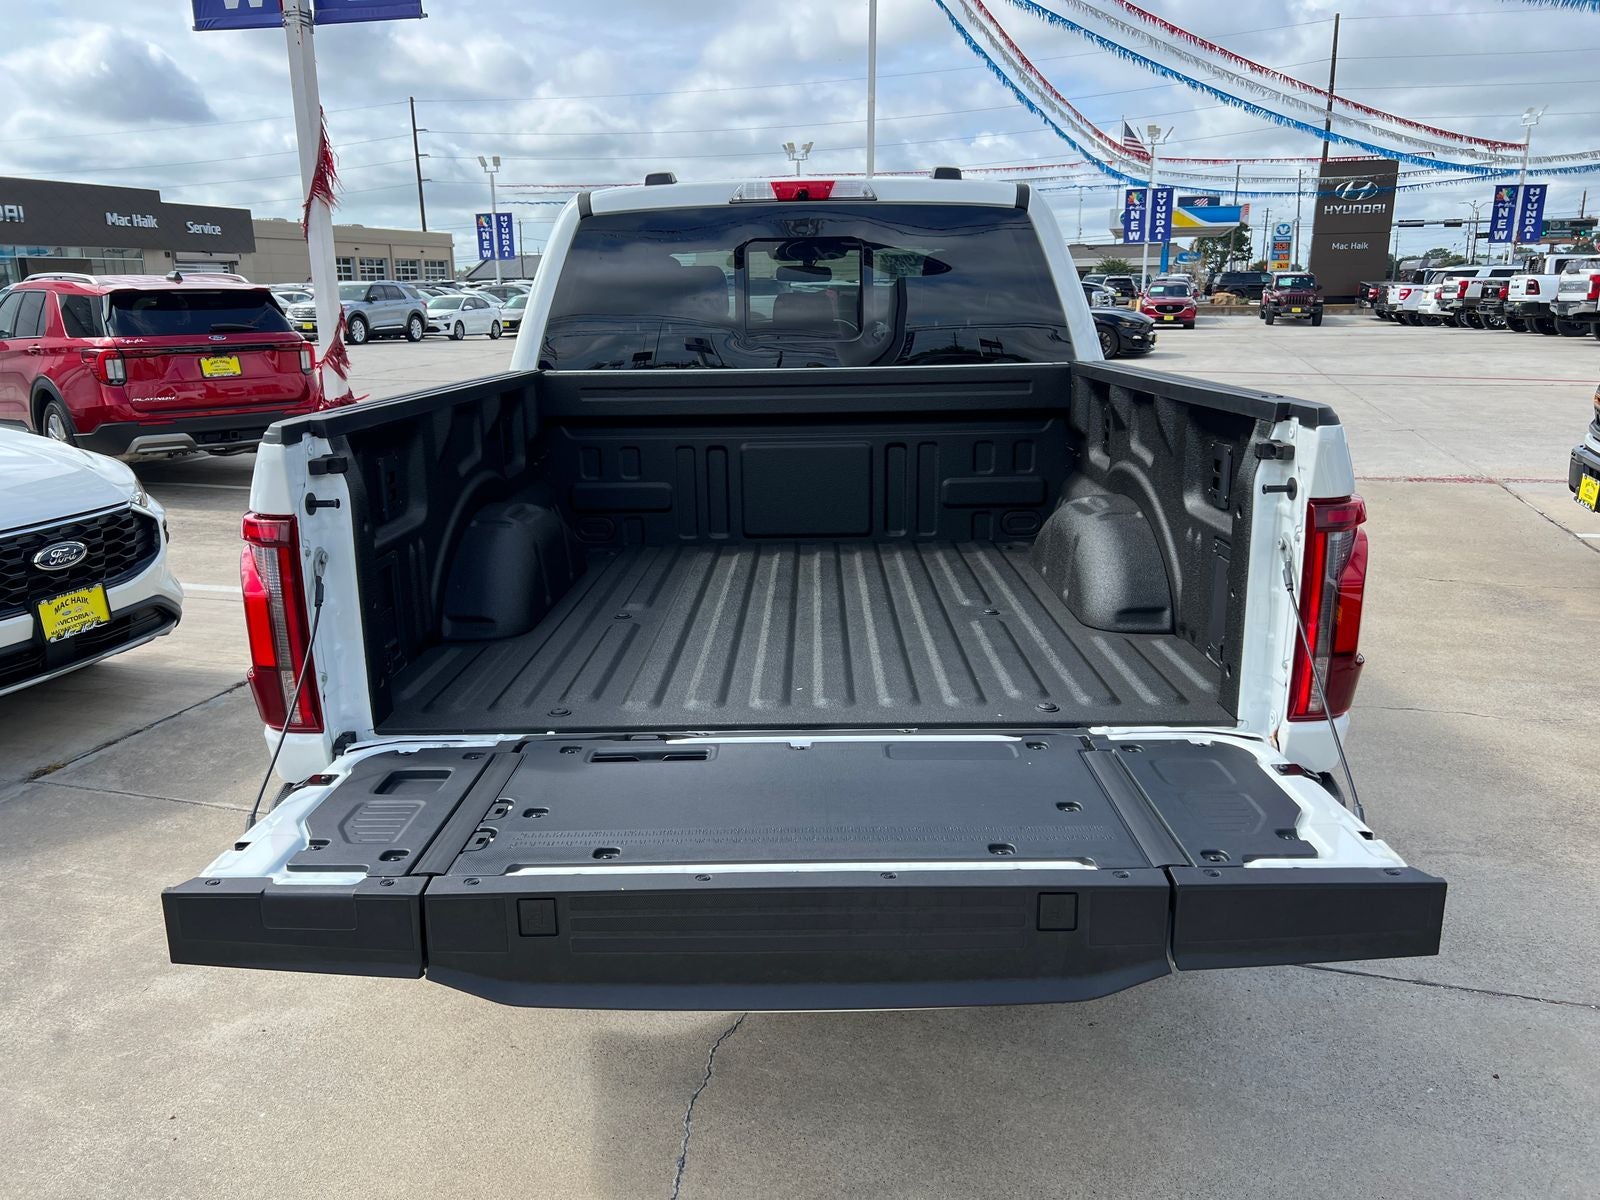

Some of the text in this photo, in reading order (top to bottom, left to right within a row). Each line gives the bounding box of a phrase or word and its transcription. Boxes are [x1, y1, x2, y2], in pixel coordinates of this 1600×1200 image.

[0, 204, 25, 223] AI
[1155, 191, 1167, 240] HYUNDAI
[1323, 203, 1386, 215] HYUNDAI
[1523, 187, 1540, 240] HYUNDAI
[106, 212, 158, 228] Mac Haik
[186, 221, 222, 236] Service
[1128, 210, 1141, 241] NEW
[1493, 207, 1509, 240] NEW
[482, 232, 491, 258] NEW
[500, 216, 510, 257] HYUNDAI
[1331, 241, 1369, 250] Mac Haik
[49, 547, 77, 566] Ford
[54, 596, 90, 615] MAC HAIK
[59, 611, 89, 626] VICTORIA
